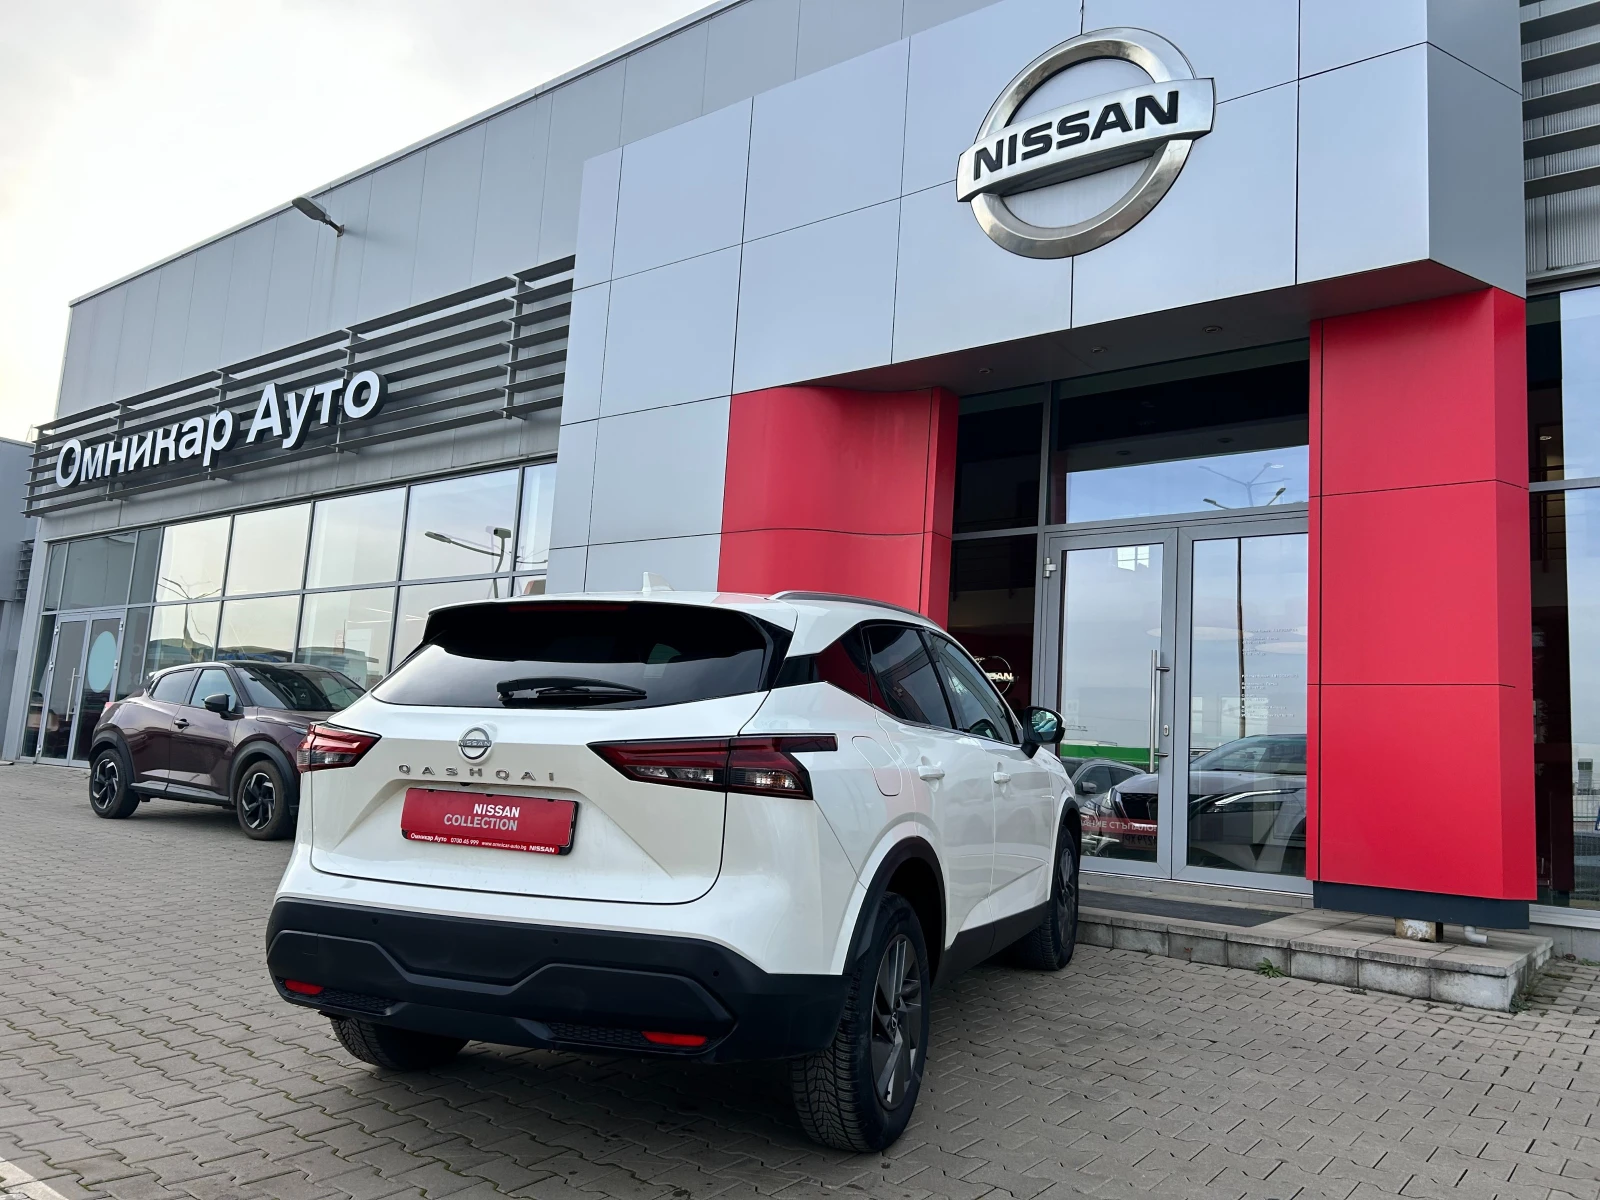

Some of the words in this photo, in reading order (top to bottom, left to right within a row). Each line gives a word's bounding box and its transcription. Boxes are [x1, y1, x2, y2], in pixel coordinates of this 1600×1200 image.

[973, 90, 1180, 181] NISSAN
[55, 409, 234, 488] Омникар
[246, 370, 381, 449] Ауто
[458, 739, 492, 748] NISSAN
[398, 764, 555, 782] QASHQAI
[473, 803, 520, 818] NISSAN
[443, 813, 518, 832] COLLECTION
[410, 832, 433, 842] Омникар
[433, 835, 447, 843] Ауто
[481, 841, 527, 851] www.omnicar-auto.bg
[529, 845, 555, 853] NISSAN
